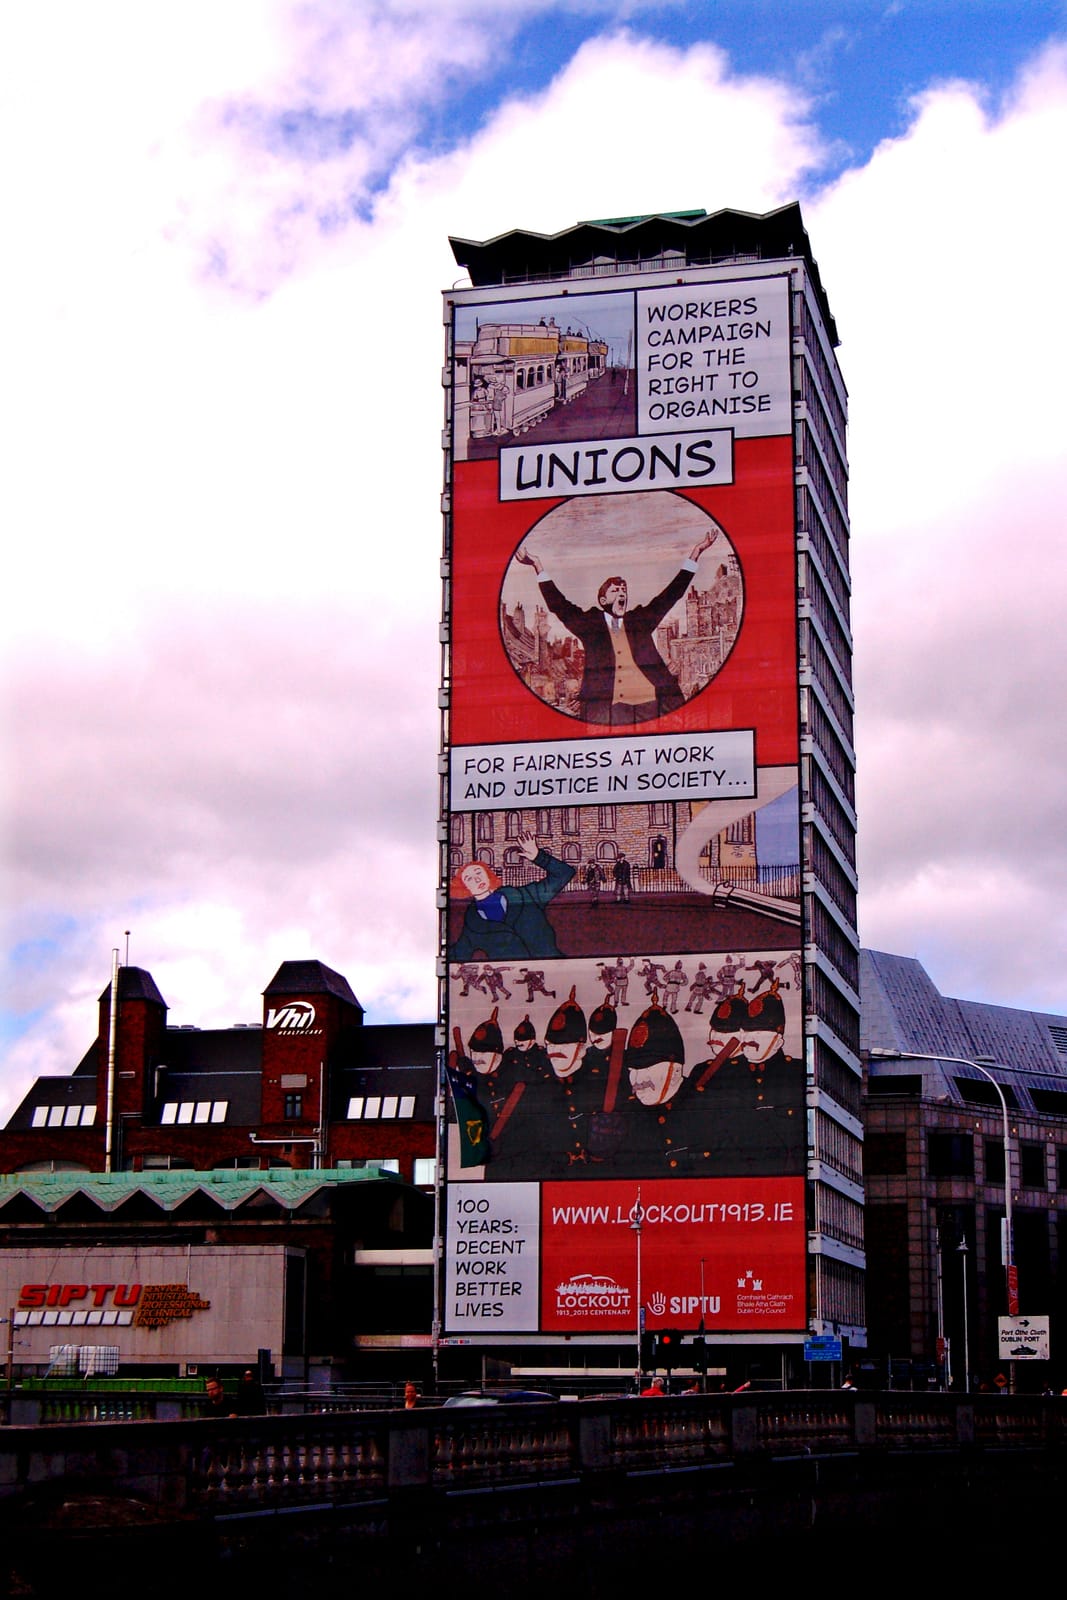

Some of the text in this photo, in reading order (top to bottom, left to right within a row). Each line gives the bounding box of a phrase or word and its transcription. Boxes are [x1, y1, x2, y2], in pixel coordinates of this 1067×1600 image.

[647, 297, 758, 324] WORKERS
[647, 320, 771, 347] CAMPAIGN
[648, 347, 746, 372] FOR THE
[648, 371, 759, 396] RIGHT TO
[649, 394, 771, 420] ORGANISE
[516, 439, 716, 491] UNIONS
[464, 745, 714, 775] FOR FAIRNESS AT WORK
[464, 769, 748, 799] AND JUSTICE IN SOCIETY...
[266, 1008, 312, 1029] Vhi
[456, 1199, 489, 1213] 100
[551, 1202, 793, 1224] WWW.LOCKOUT1913.IE
[456, 1219, 519, 1234] YEARS:
[455, 1239, 525, 1255] DECENT
[455, 1260, 506, 1275] WORK
[18, 1284, 142, 1307] SIPTU
[455, 1280, 522, 1296] BETTER
[141, 1300, 210, 1309] PROFESSIONAL
[454, 1302, 504, 1317] LIVES
[557, 1295, 631, 1308] LOCKOUT
[669, 1296, 721, 1314] SIPTU
[139, 1309, 192, 1318] TECHNICAL
[590, 1308, 631, 1316] CENTENARY
